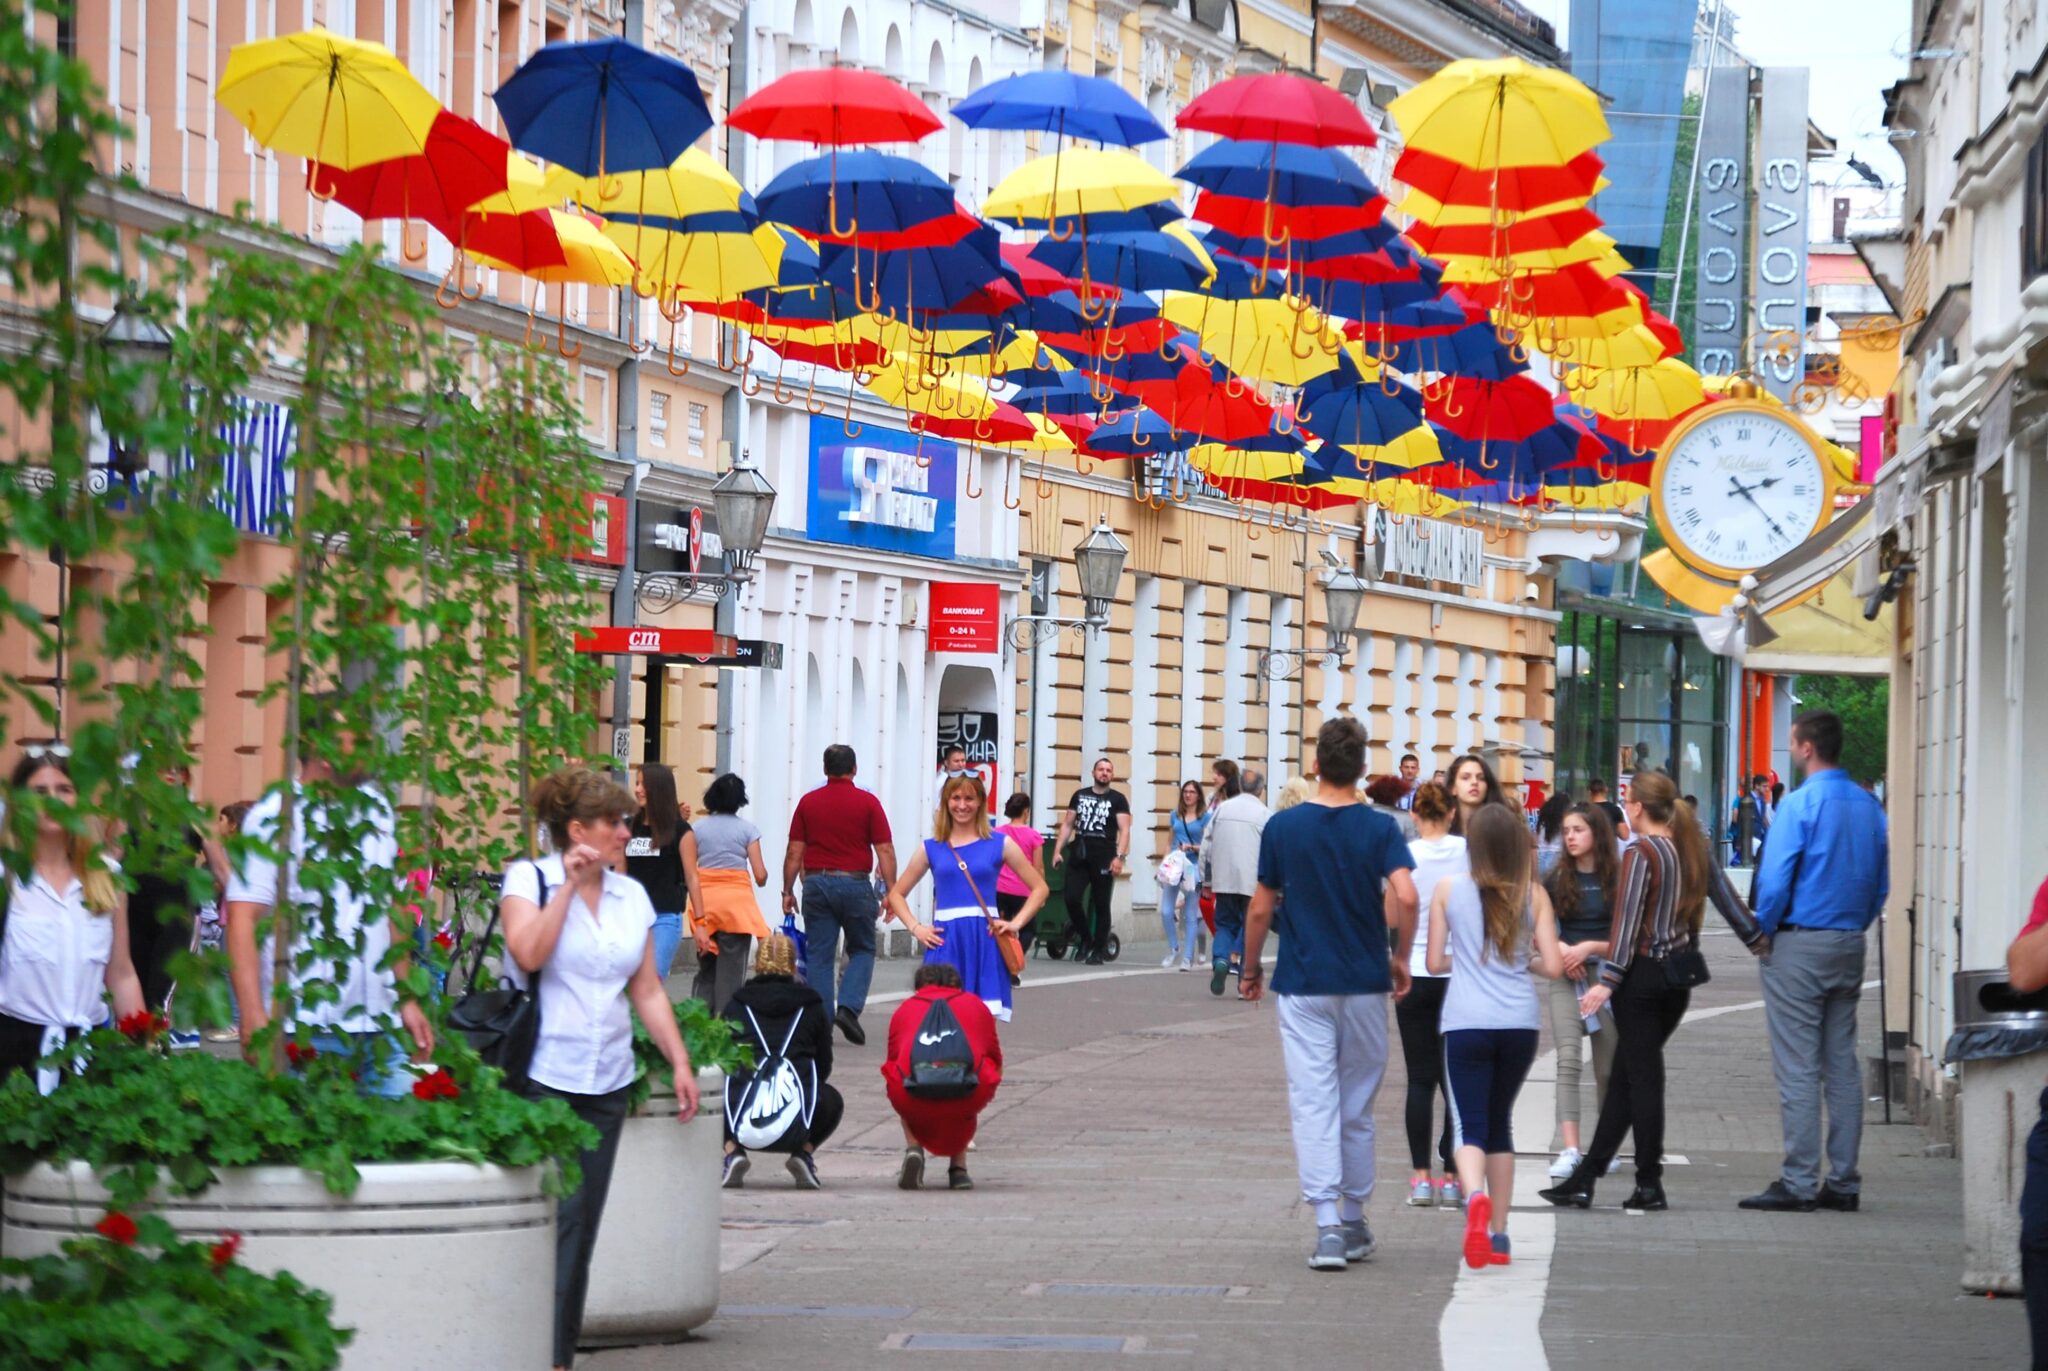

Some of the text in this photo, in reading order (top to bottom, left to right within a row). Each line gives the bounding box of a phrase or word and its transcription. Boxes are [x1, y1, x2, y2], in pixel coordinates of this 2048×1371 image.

[1758, 158, 1801, 383] anova
[1737, 429, 1752, 441] XII
[942, 607, 985, 616] BANKOMAT
[949, 626, 976, 635] 0-24 h
[629, 631, 660, 646] cm
